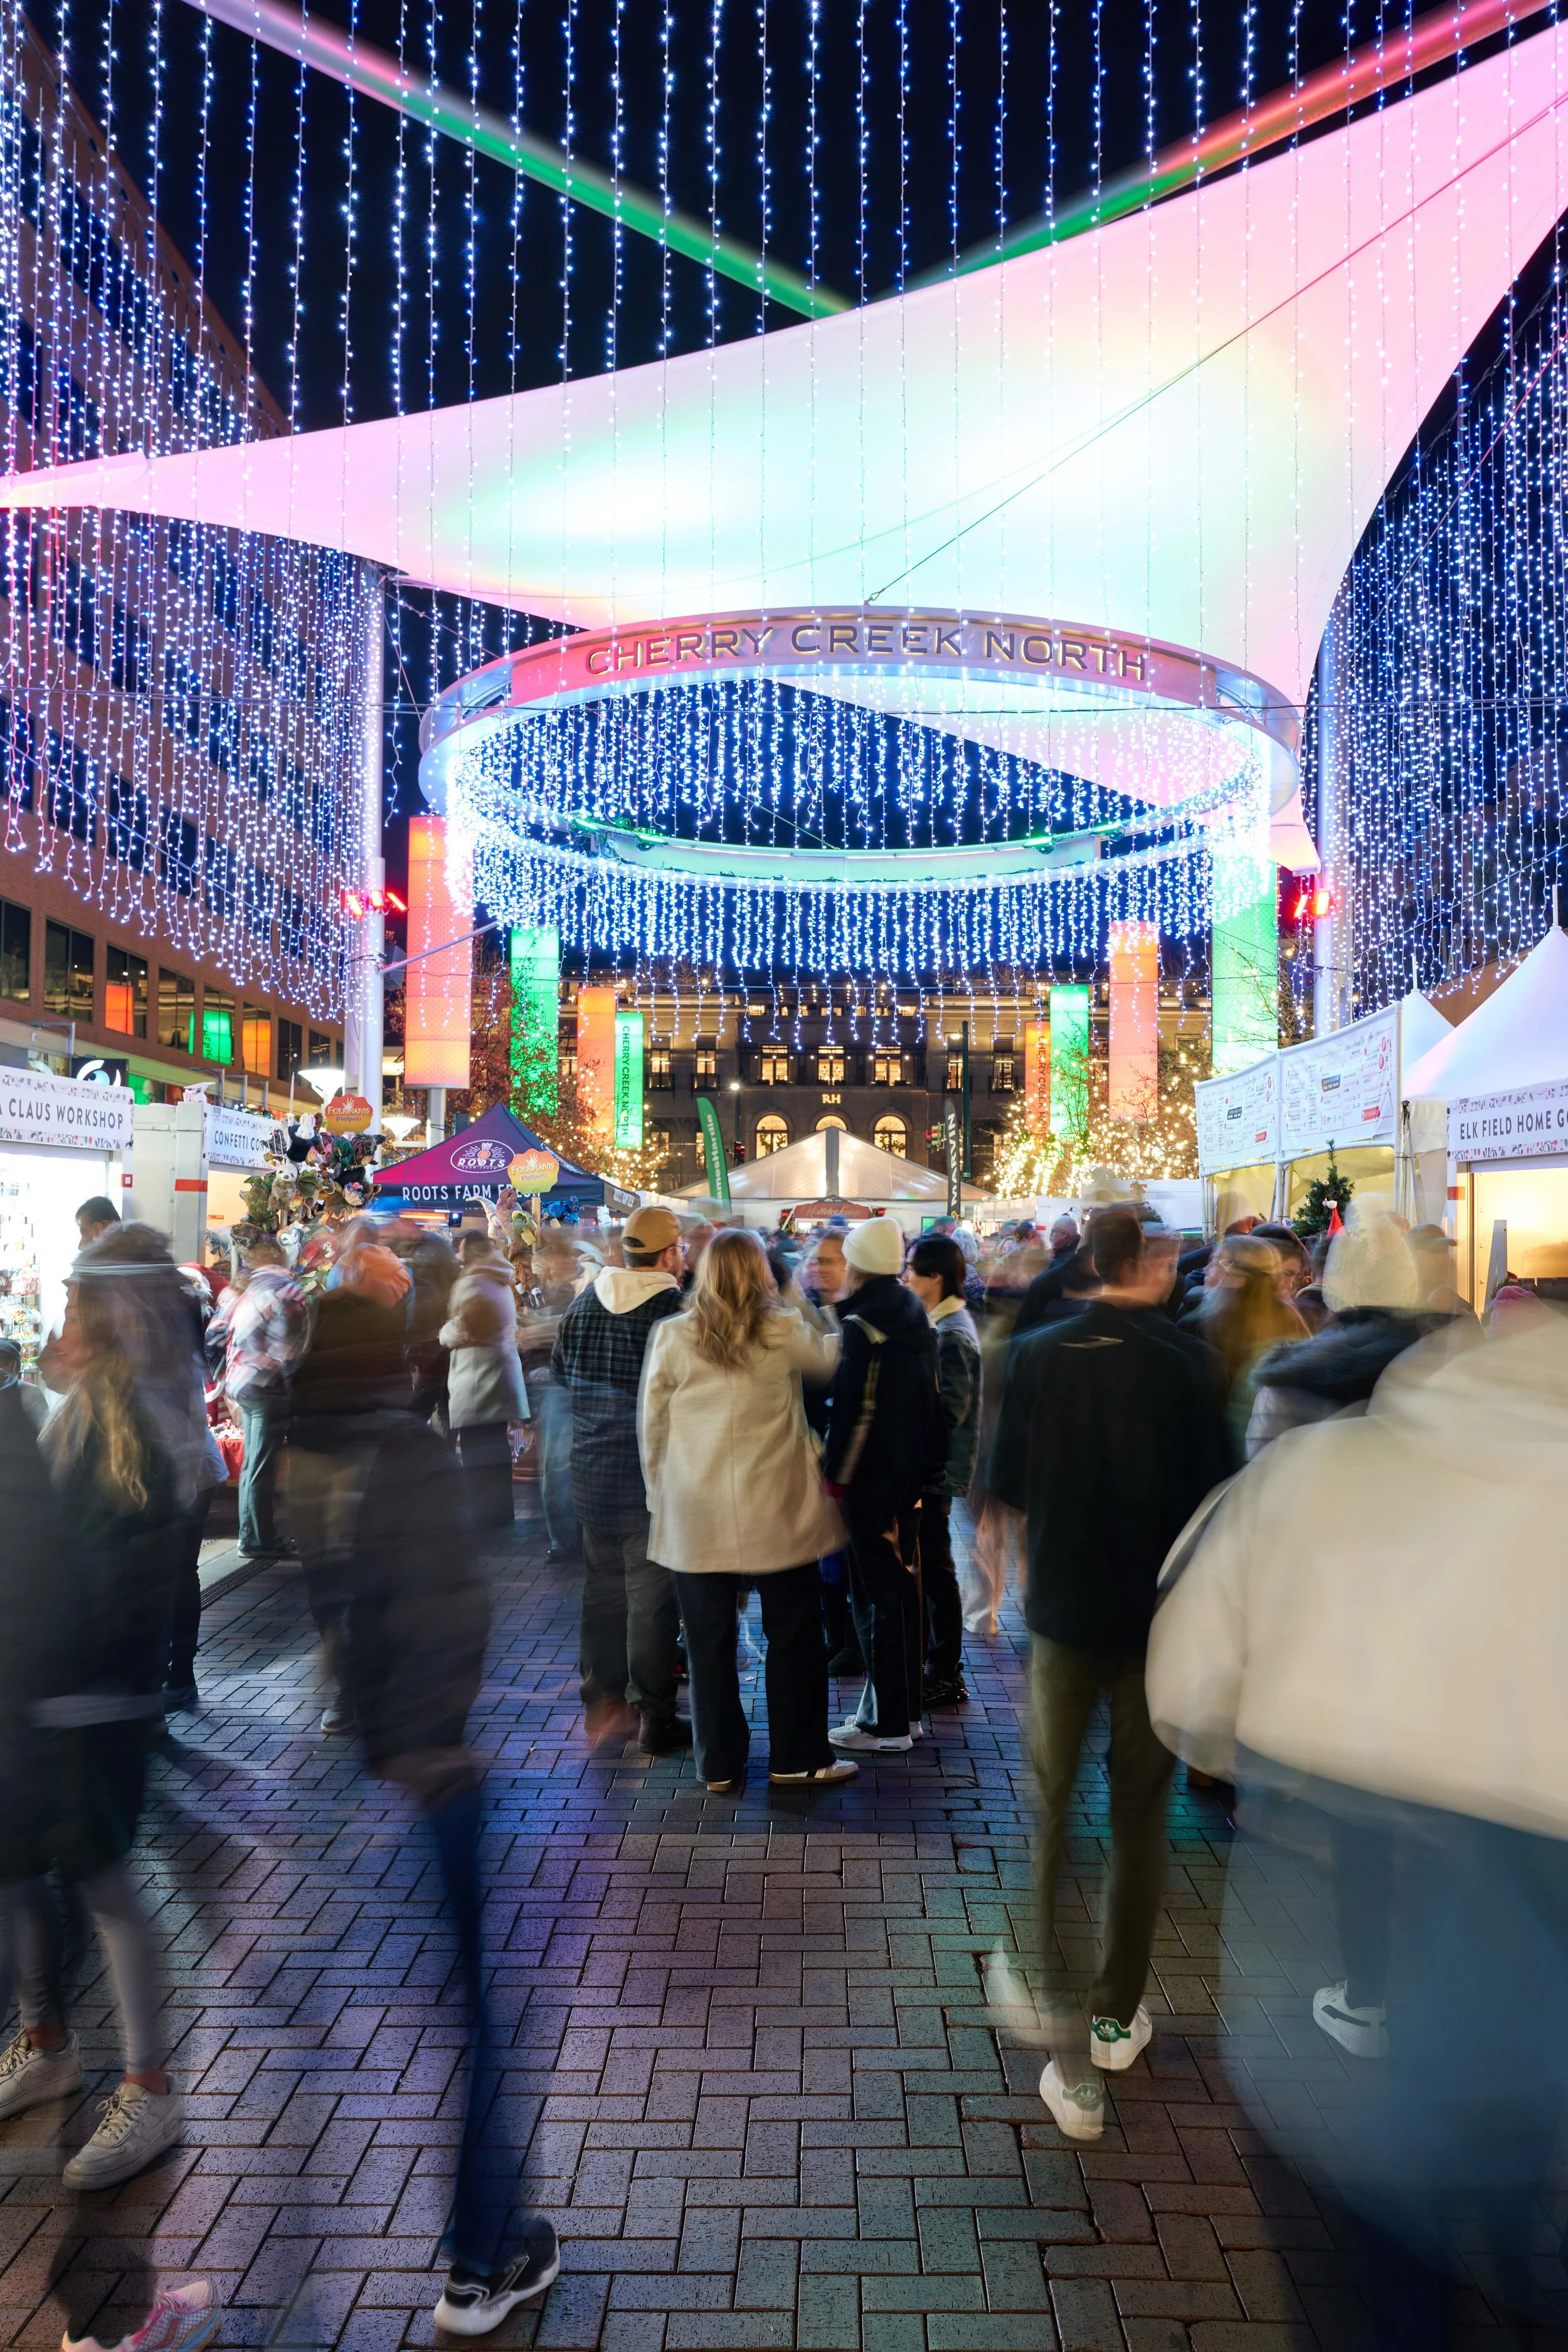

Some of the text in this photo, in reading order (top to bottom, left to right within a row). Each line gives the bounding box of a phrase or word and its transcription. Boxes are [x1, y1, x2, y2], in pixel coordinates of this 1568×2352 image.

[585, 624, 1146, 681] CHERRY CREEK NORTH
[622, 1025, 630, 1066] CHERRY
[822, 1093, 841, 1104] RH
[9, 1098, 50, 1121] CLAUS
[56, 1104, 123, 1129] WORKSHOP
[1460, 1108, 1568, 1140] ELK FIELD HOME G
[215, 1130, 248, 1150] CONFETTI
[457, 1158, 506, 1167] ROOTS
[948, 1113, 957, 1207] MARVIN
[521, 1173, 548, 1181] Puppets
[402, 1185, 448, 1201] ROOTS
[455, 1184, 492, 1200] FARM
